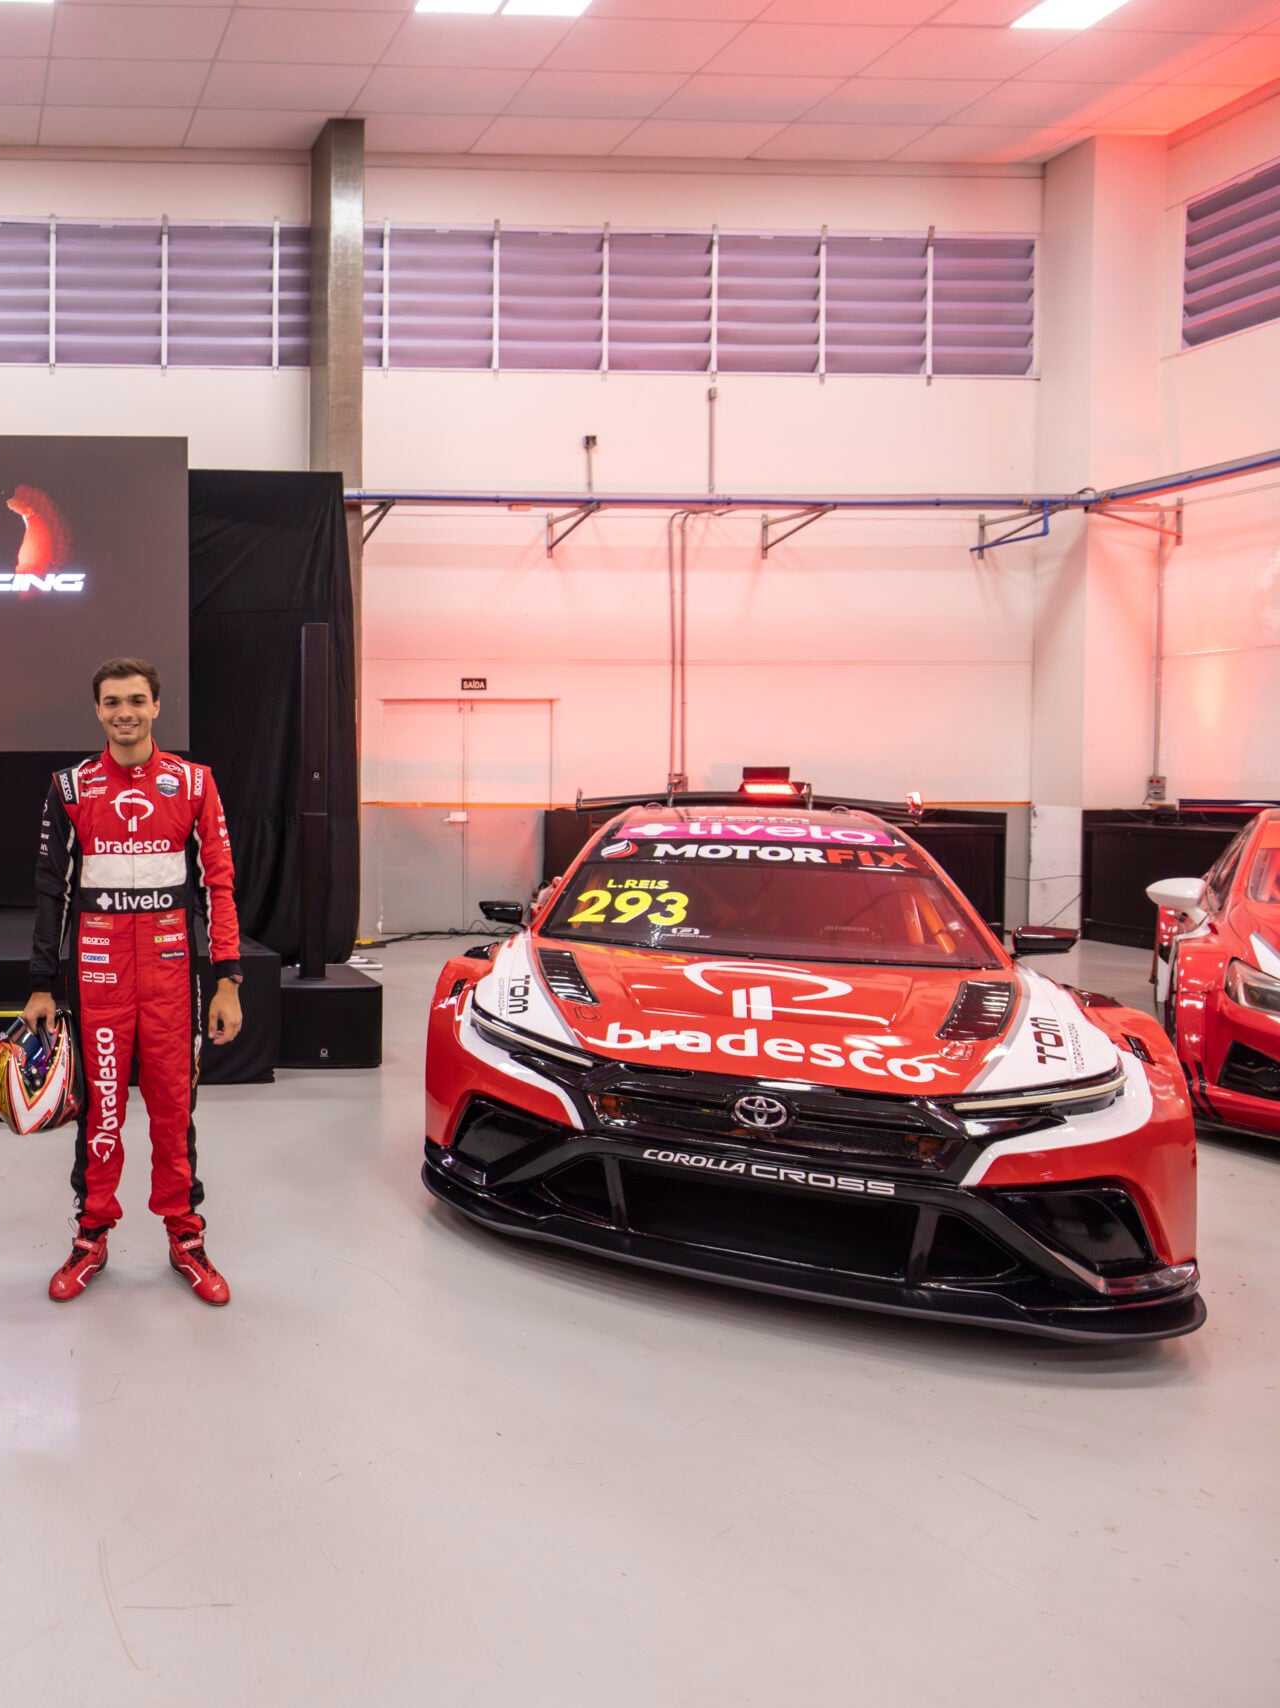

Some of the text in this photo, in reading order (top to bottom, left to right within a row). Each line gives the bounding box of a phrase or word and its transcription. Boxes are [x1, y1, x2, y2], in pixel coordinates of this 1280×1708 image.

[463, 679, 485, 689] SAÍDA
[688, 822, 879, 843] livelo
[94, 837, 171, 853] bradesco
[653, 844, 921, 869] MOTORFIX
[606, 879, 670, 890] L.REIS
[114, 891, 173, 911] livelo
[567, 889, 689, 926] 293
[82, 971, 117, 984] 293
[605, 1022, 936, 1083] bradesco
[93, 1027, 119, 1131] bradesco
[642, 1149, 896, 1196] COROLLA CROSS
